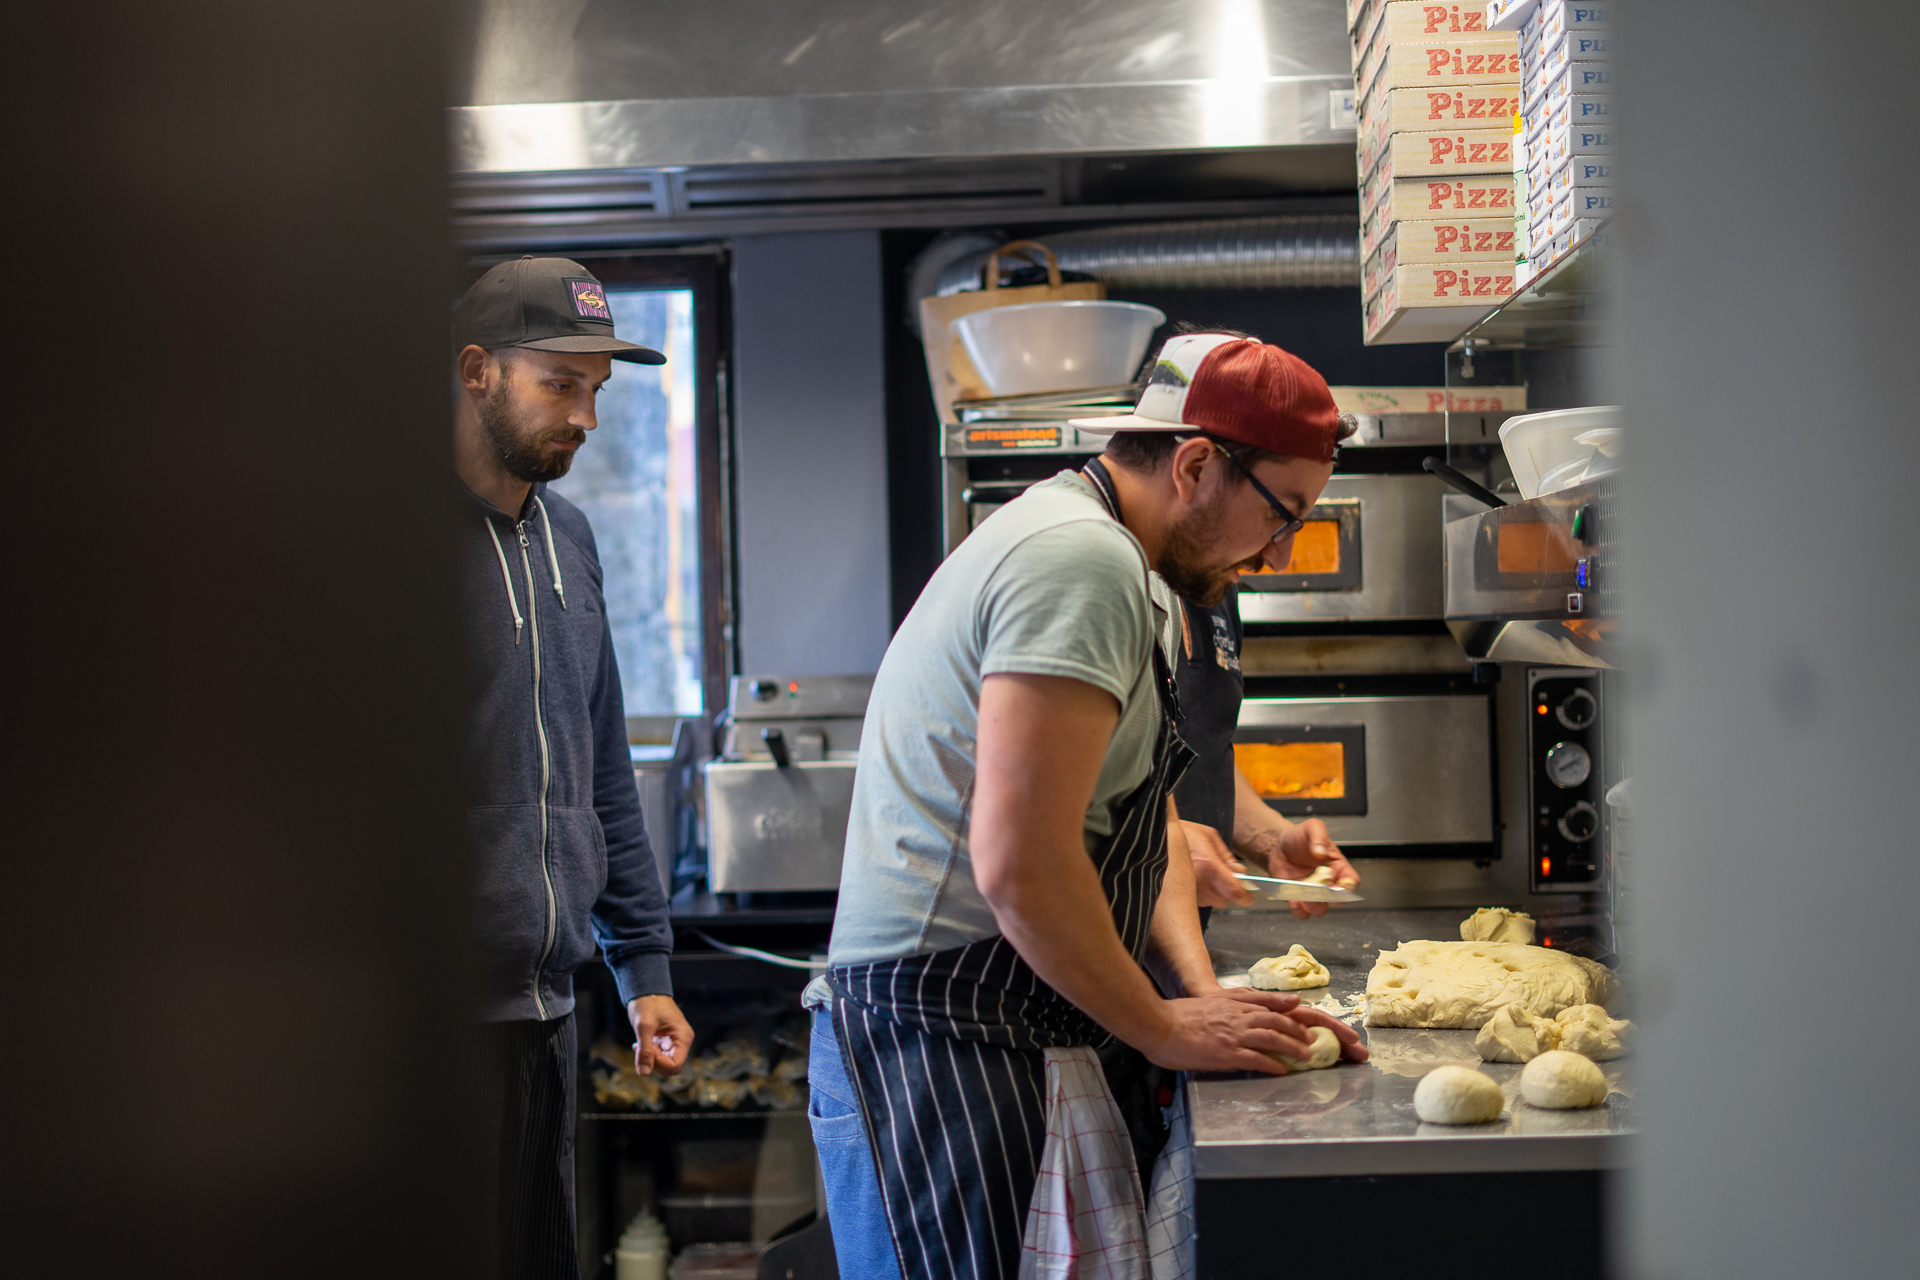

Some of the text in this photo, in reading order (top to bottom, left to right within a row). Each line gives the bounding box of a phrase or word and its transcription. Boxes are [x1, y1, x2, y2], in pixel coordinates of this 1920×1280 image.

[1423, 5, 1488, 33] Piz
[1429, 137, 1513, 164] Pizz
[1427, 182, 1514, 210] Pizz
[1434, 225, 1514, 253] Pizz
[1433, 269, 1513, 297] Pizz
[1425, 391, 1503, 413] Pizza
